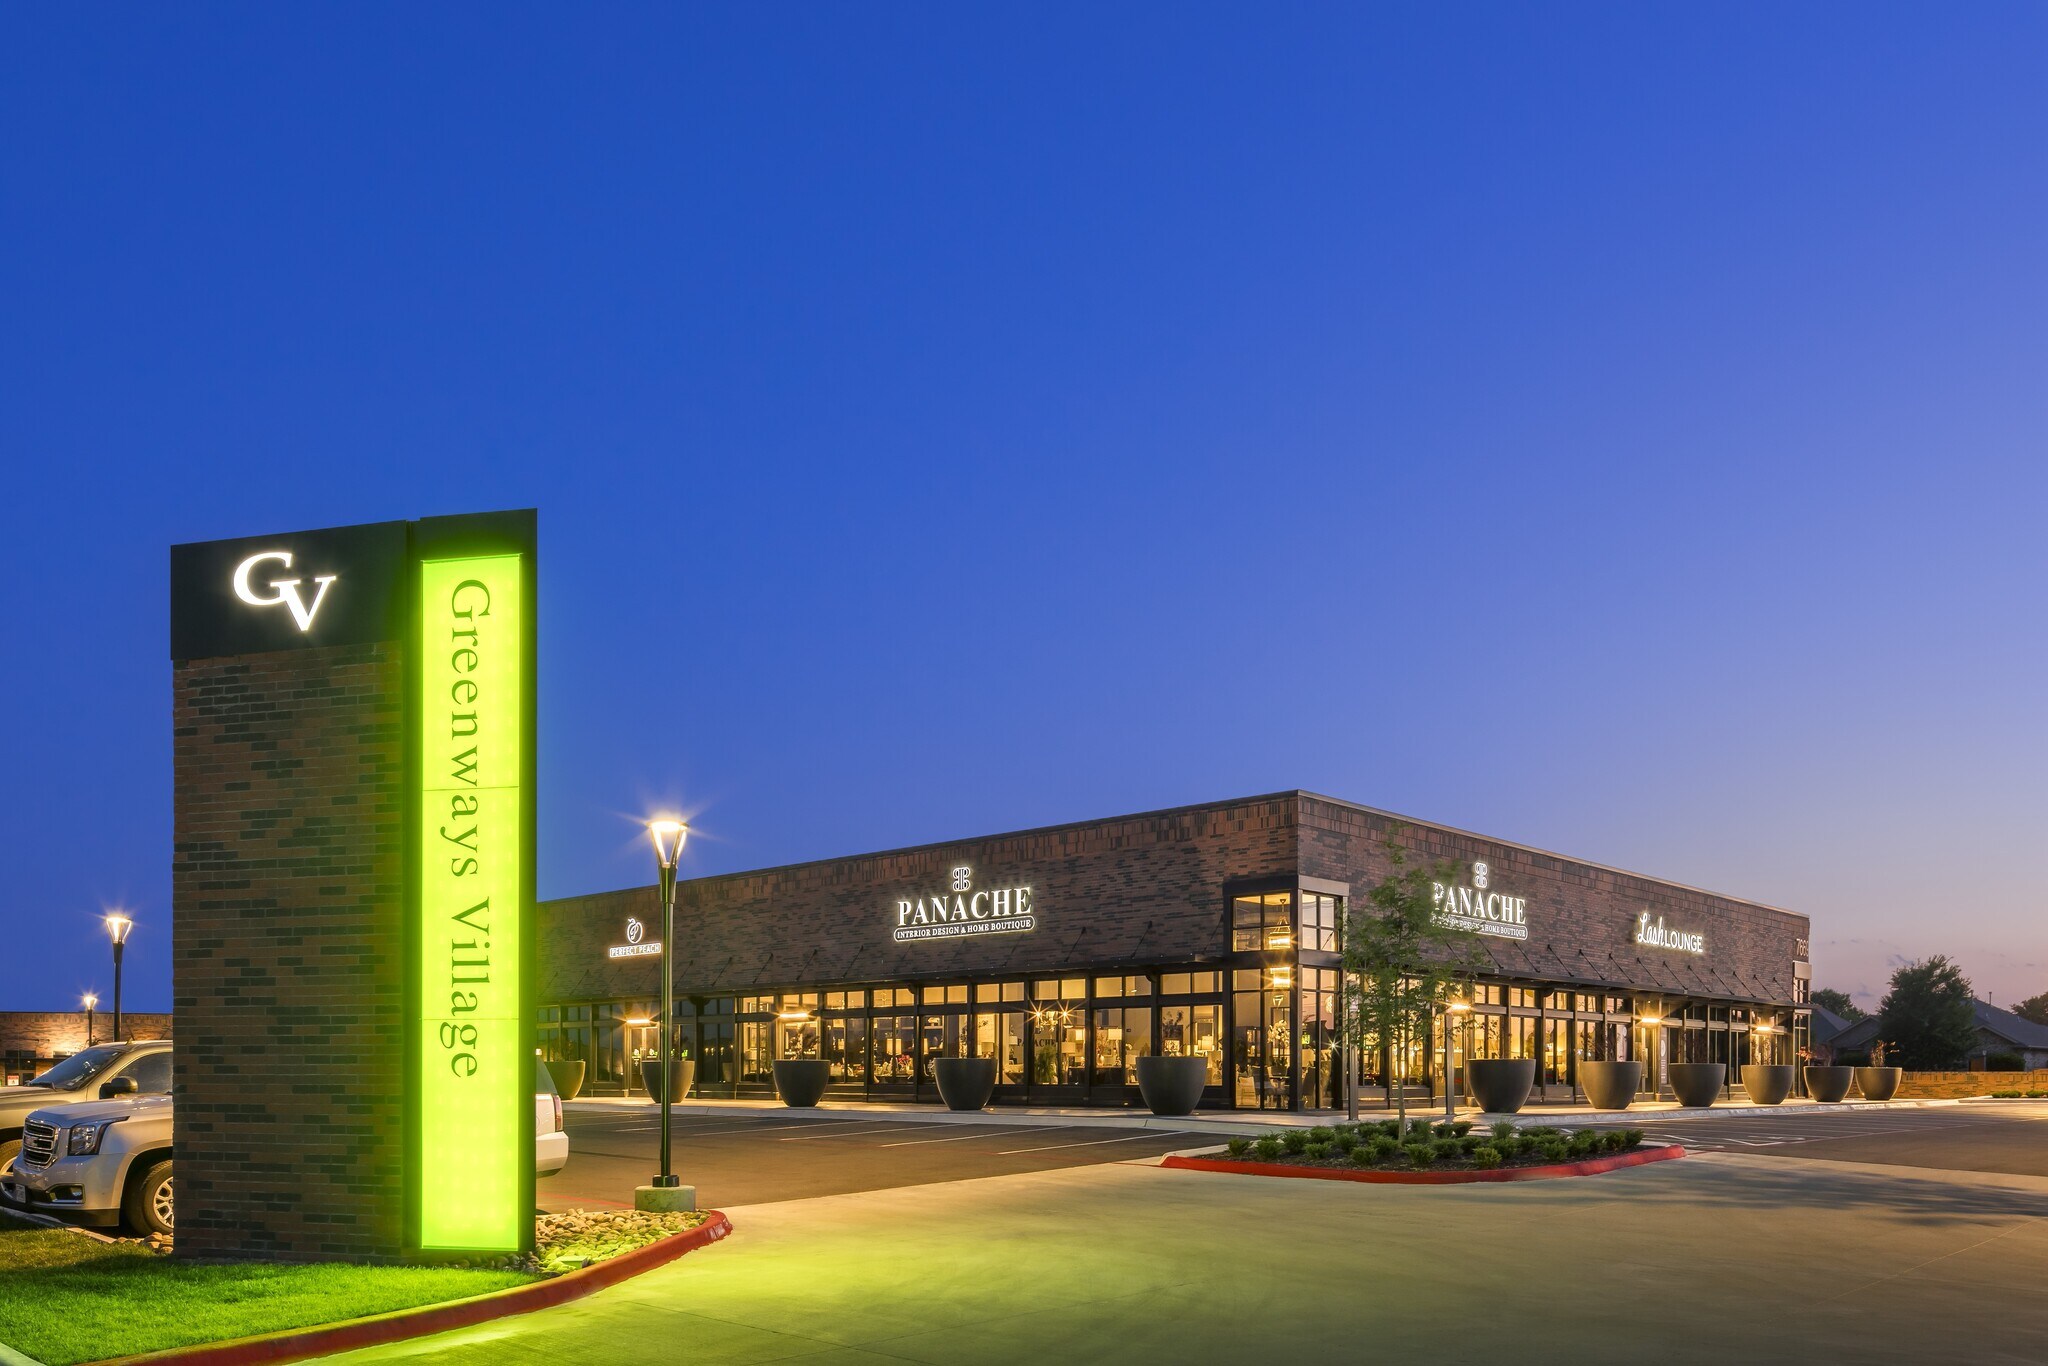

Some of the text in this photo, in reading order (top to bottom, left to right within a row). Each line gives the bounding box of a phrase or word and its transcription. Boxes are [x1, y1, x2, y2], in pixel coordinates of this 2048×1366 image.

[233, 551, 337, 632] GV
[439, 579, 491, 1078] Greenways Village
[897, 887, 1031, 926] PANACHE
[1433, 882, 1526, 924] PANACHE
[897, 929, 931, 939] INTERIOR
[932, 926, 960, 936] DESIGN
[967, 923, 990, 933] HOME
[990, 919, 1031, 931] BOUTIQUE
[1501, 927, 1526, 937] BOUTIQUE
[1637, 912, 1703, 953] Lash LOUNGE
[611, 944, 660, 956] PERFECT PEACH
